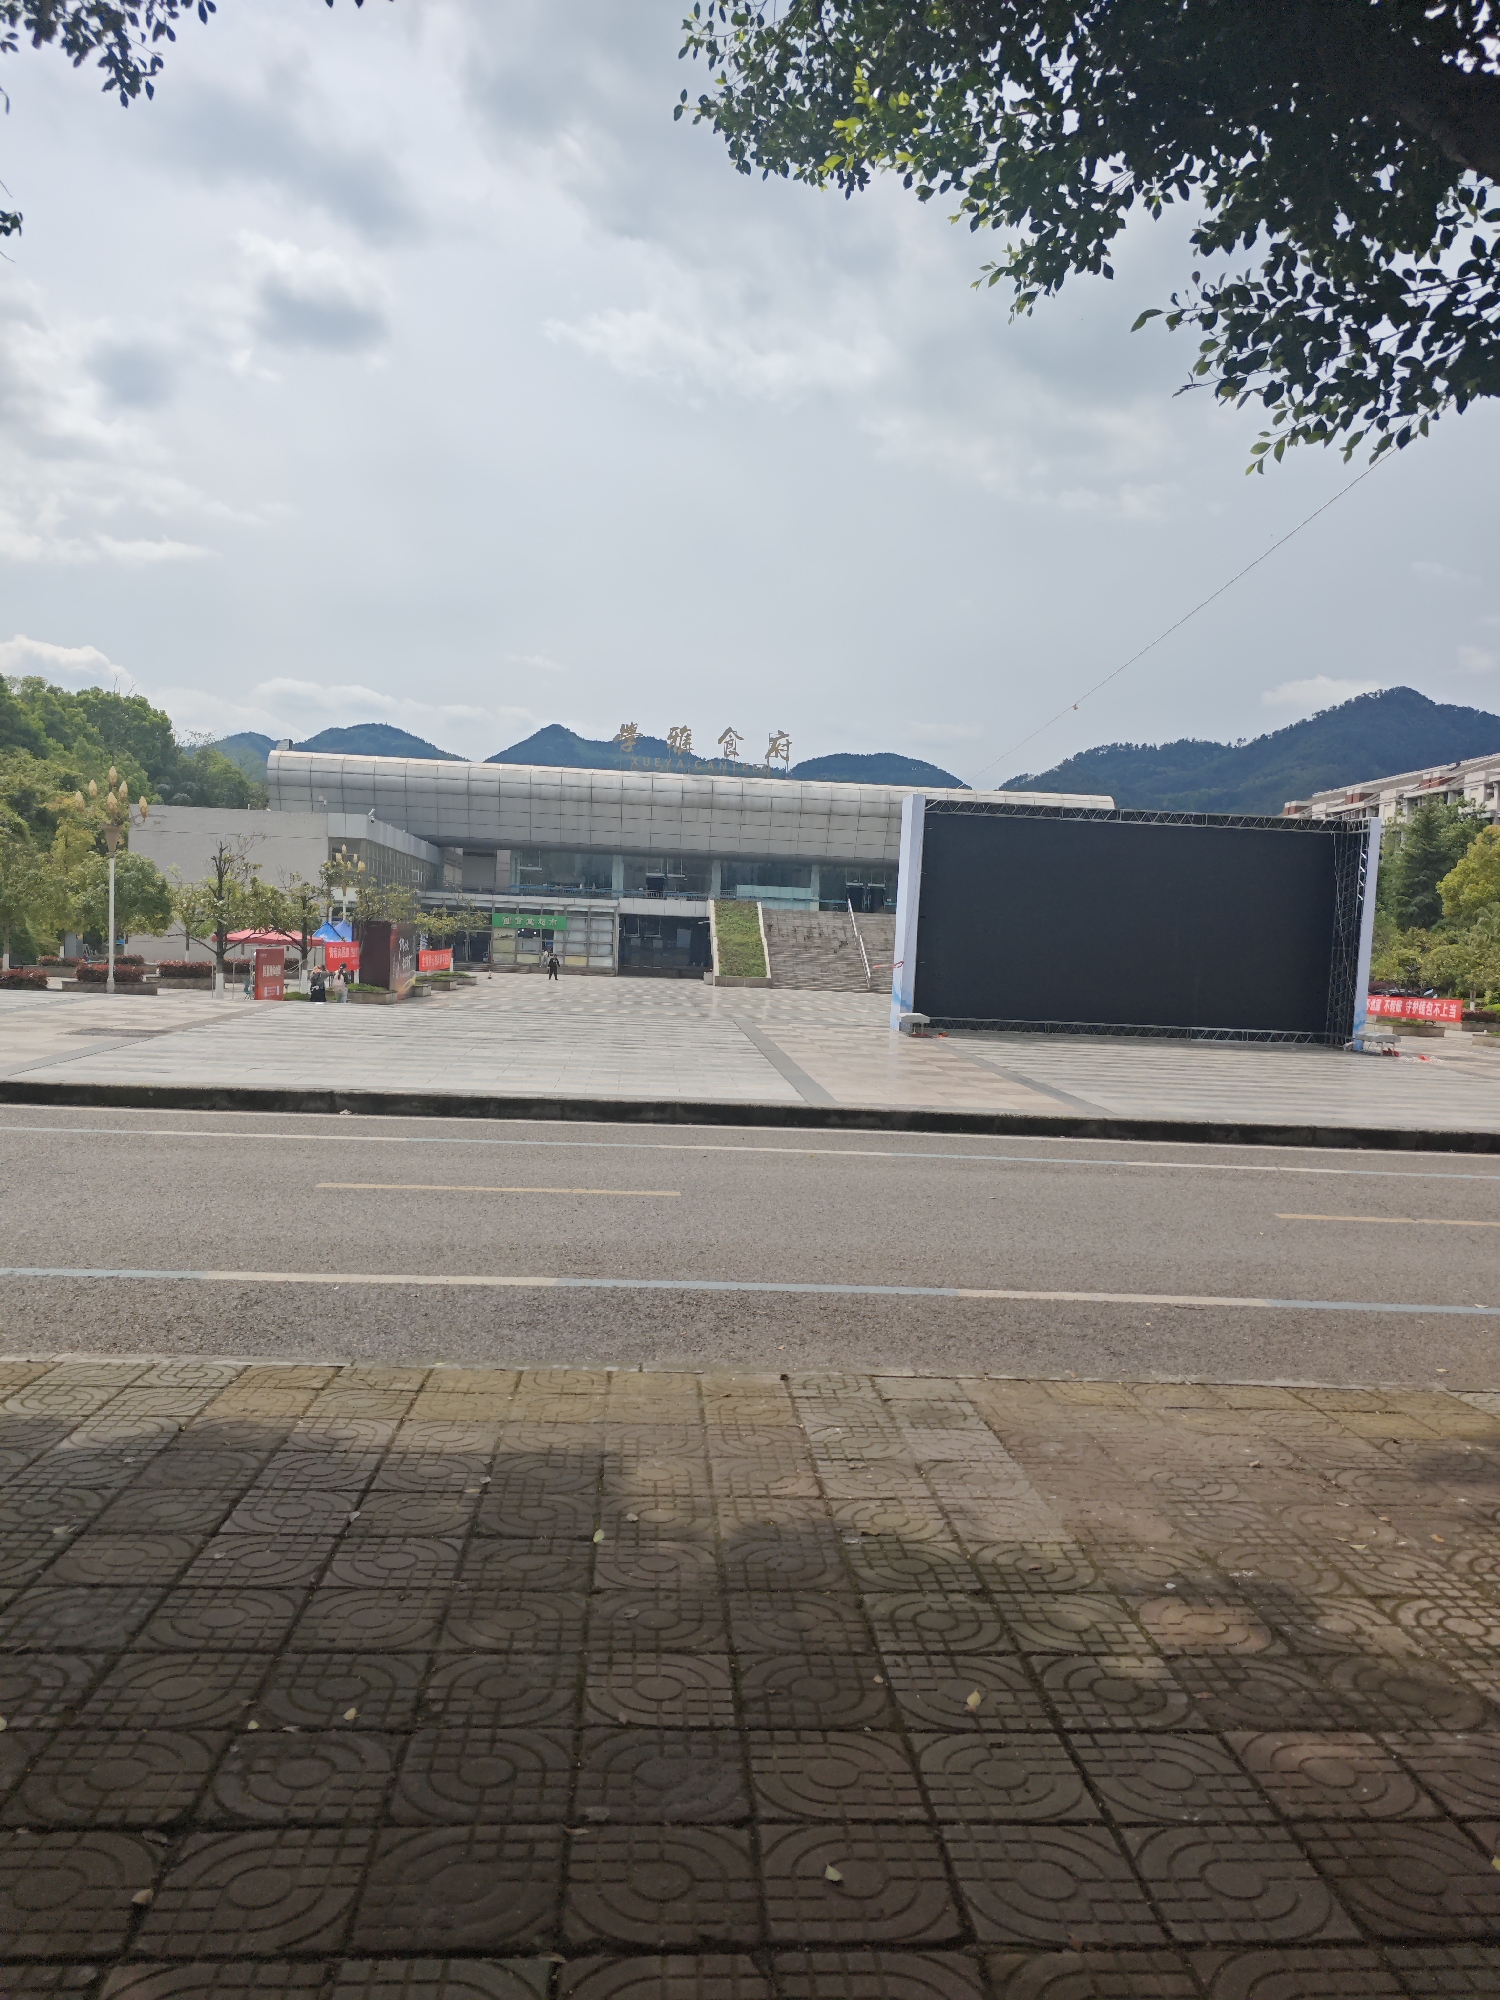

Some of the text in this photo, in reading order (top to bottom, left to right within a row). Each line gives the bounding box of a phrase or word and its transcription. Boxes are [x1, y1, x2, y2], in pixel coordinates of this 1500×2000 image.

[631, 756, 770, 773] XUEYA CANTEEN
[1405, 1000, 1457, 1018] 守护钱包不上当
